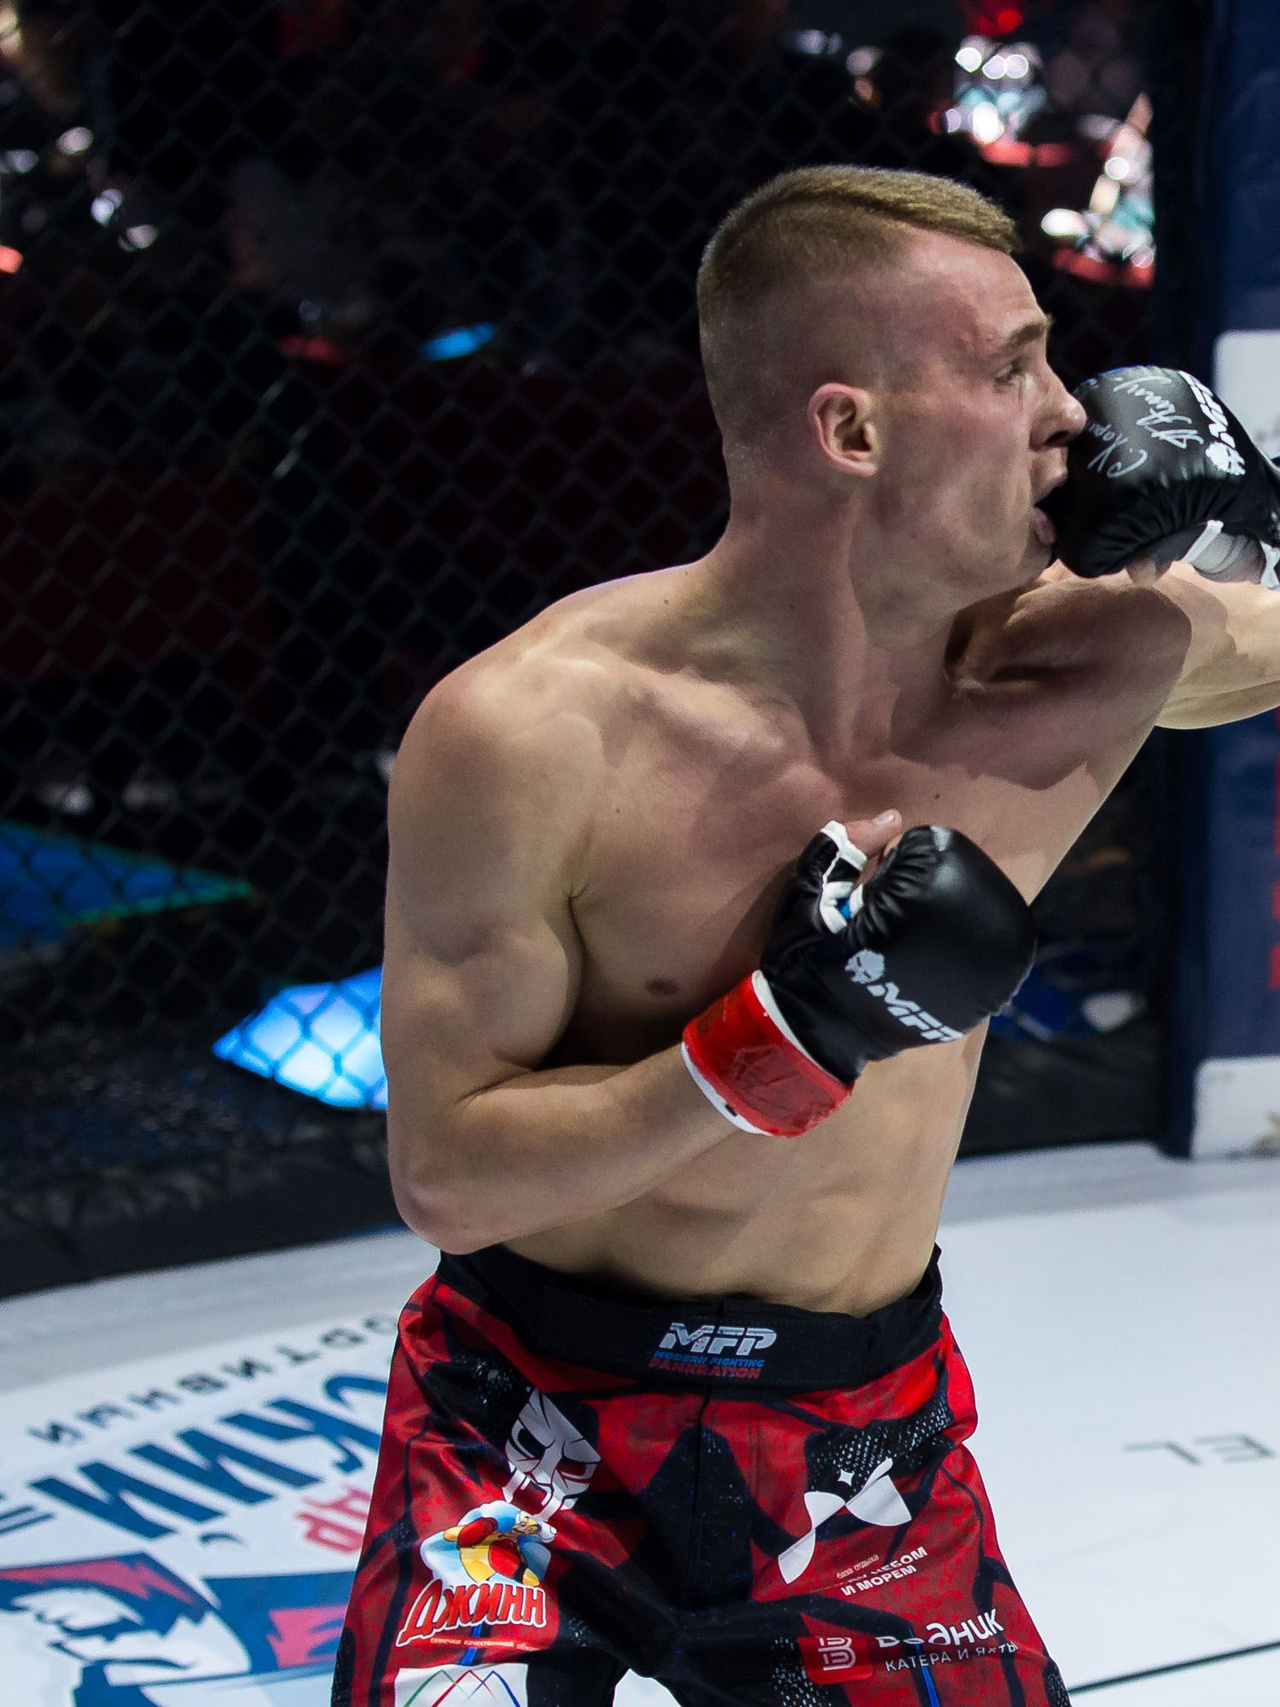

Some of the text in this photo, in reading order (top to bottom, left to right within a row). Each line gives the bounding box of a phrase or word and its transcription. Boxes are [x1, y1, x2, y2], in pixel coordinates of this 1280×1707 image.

[659, 1322, 777, 1356] MFP
[648, 1357, 762, 1379] PANKRATION
[709, 1357, 766, 1368] FIGHTING
[841, 1584, 857, 1597] И
[856, 1564, 918, 1592] МОРЕМ
[885, 1650, 951, 1672] КАТЕРА
[957, 1648, 970, 1661] И
